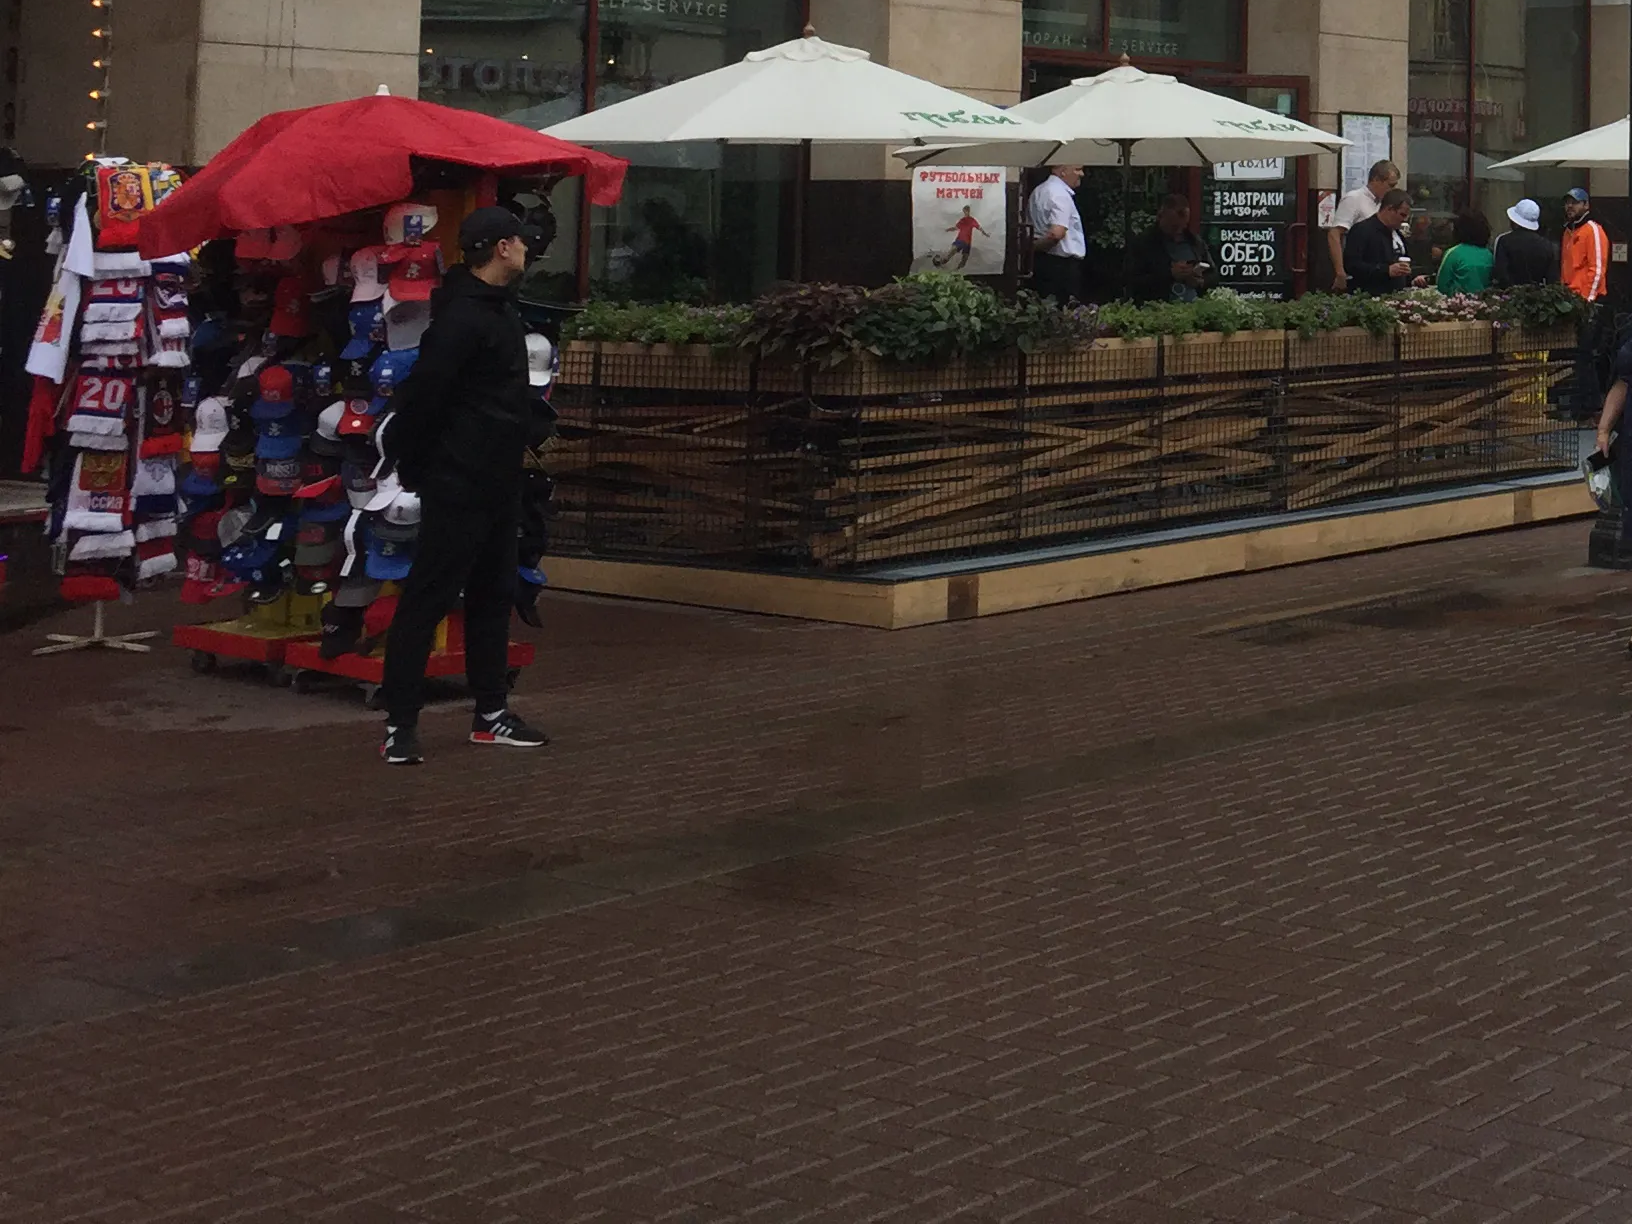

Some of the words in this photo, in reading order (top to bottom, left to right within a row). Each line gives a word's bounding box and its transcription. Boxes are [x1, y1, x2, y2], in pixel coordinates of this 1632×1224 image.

[1121, 39, 1179, 56] SERVICE
[1222, 191, 1284, 206] ЗАВТРАКИ
[1233, 206, 1251, 217] 130
[1220, 227, 1275, 242] ВКУСНЫЙ
[1220, 242, 1275, 263] ОБЕД
[1220, 264, 1236, 276] ОТ
[1241, 264, 1261, 276] 210
[79, 376, 126, 410] 20
